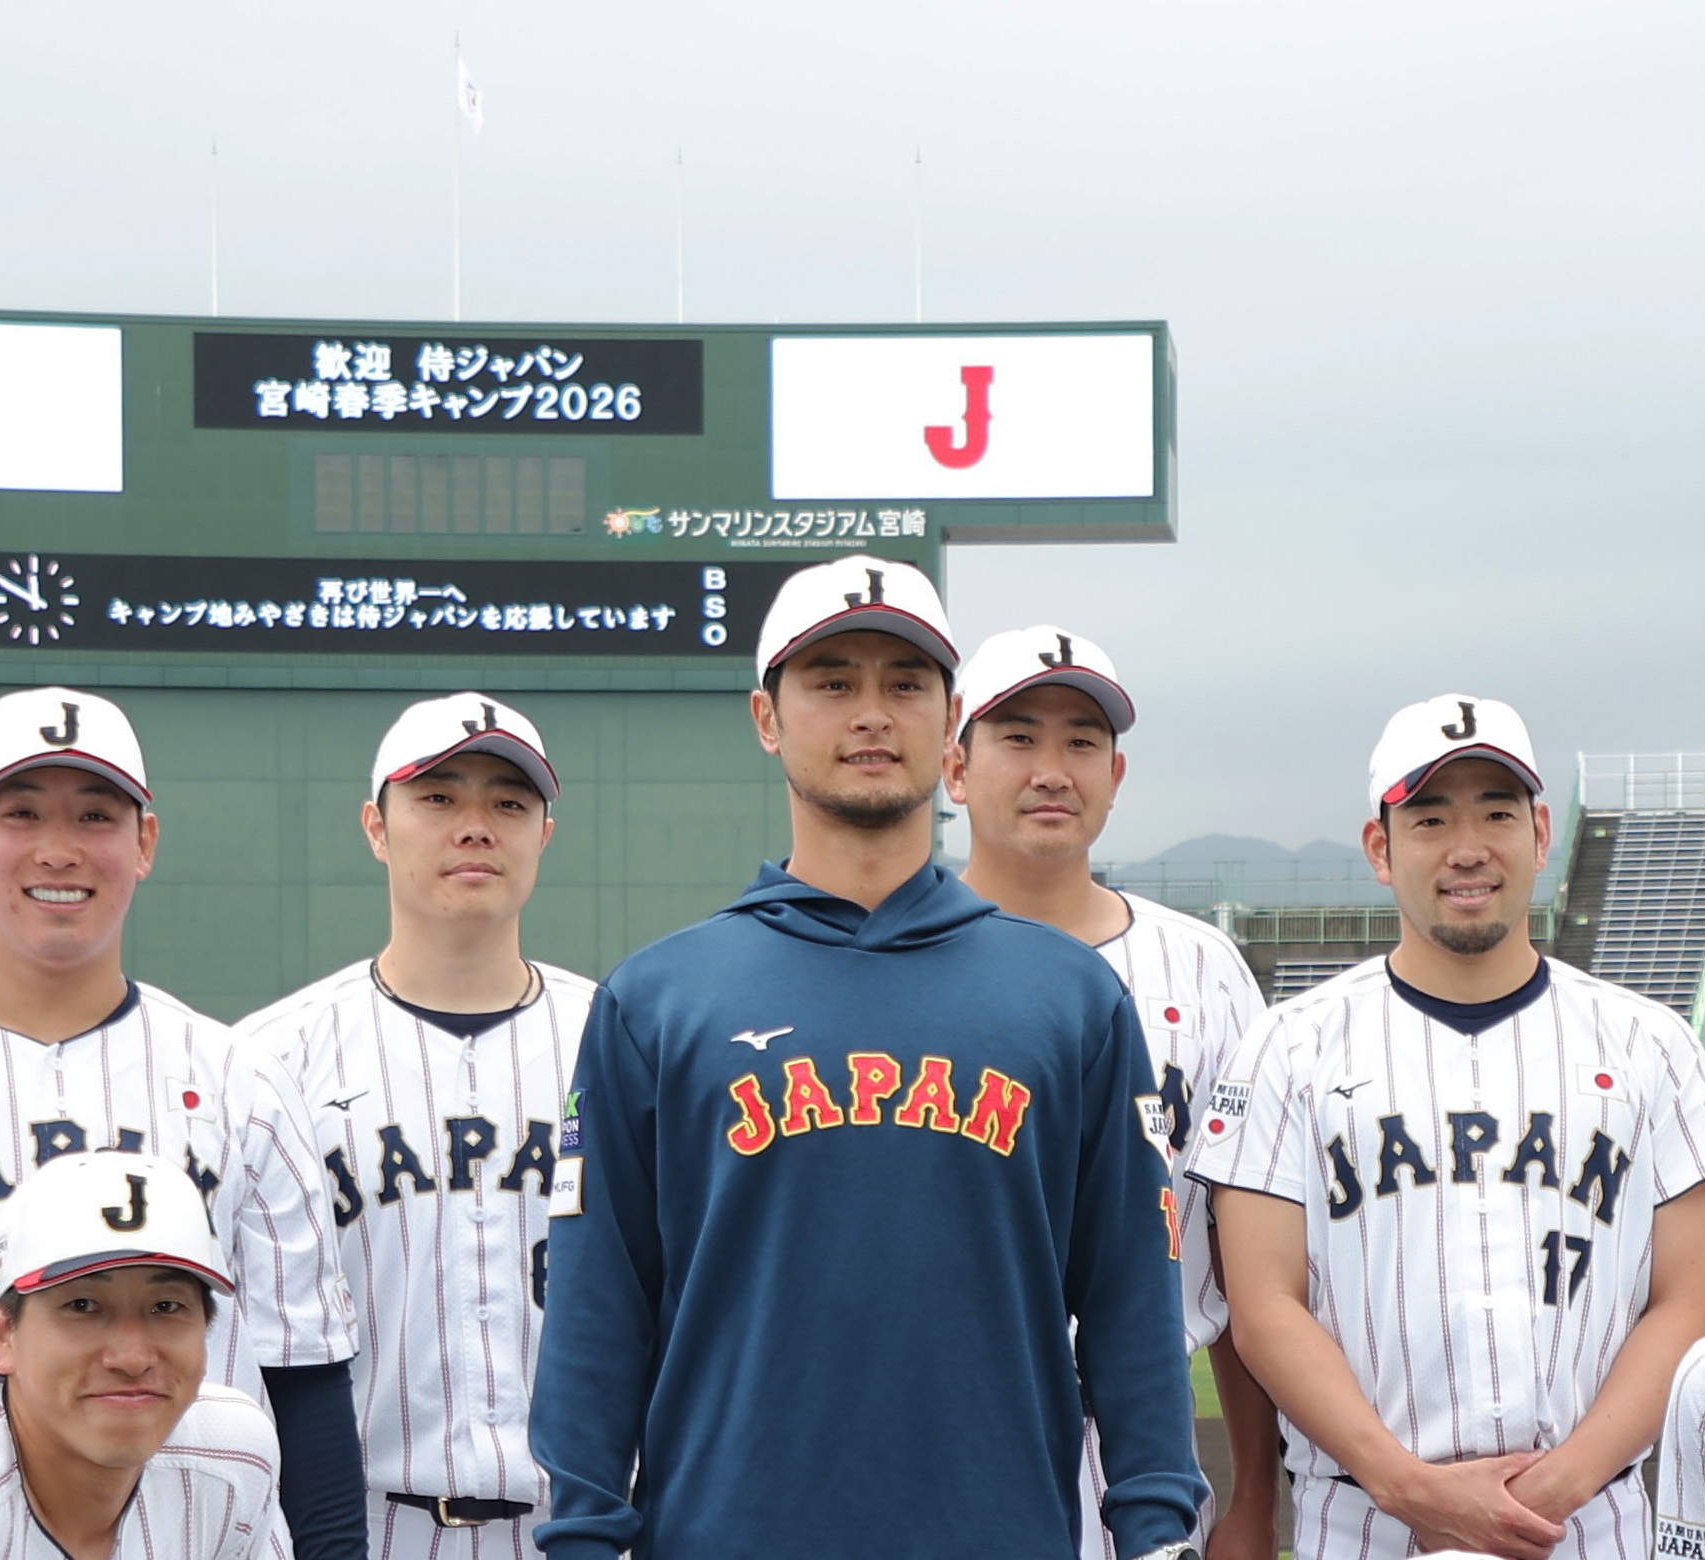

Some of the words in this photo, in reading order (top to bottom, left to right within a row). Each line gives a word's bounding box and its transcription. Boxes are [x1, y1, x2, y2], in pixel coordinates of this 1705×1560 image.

[314, 341, 392, 381] 歓迎
[418, 343, 584, 382] 侍ジャパン
[255, 377, 642, 420] 宮崎春季キャンプ2026
[924, 366, 994, 469] J
[667, 508, 927, 538] サンマリンスタジアム宮崎
[318, 577, 467, 605] 再び世界一へ
[703, 566, 727, 590] B
[704, 594, 727, 619] S
[702, 622, 728, 647] O
[1038, 634, 1073, 668] J
[40, 702, 79, 746] J
[1441, 701, 1477, 741] J
[727, 1053, 1031, 1156] JAPAN
[1208, 1095, 1247, 1117] APAN
[323, 1114, 559, 1229] JAPA
[1325, 1110, 1632, 1229] JAPAN
[101, 1173, 148, 1232] J
[1541, 1230, 1593, 1310] 17
